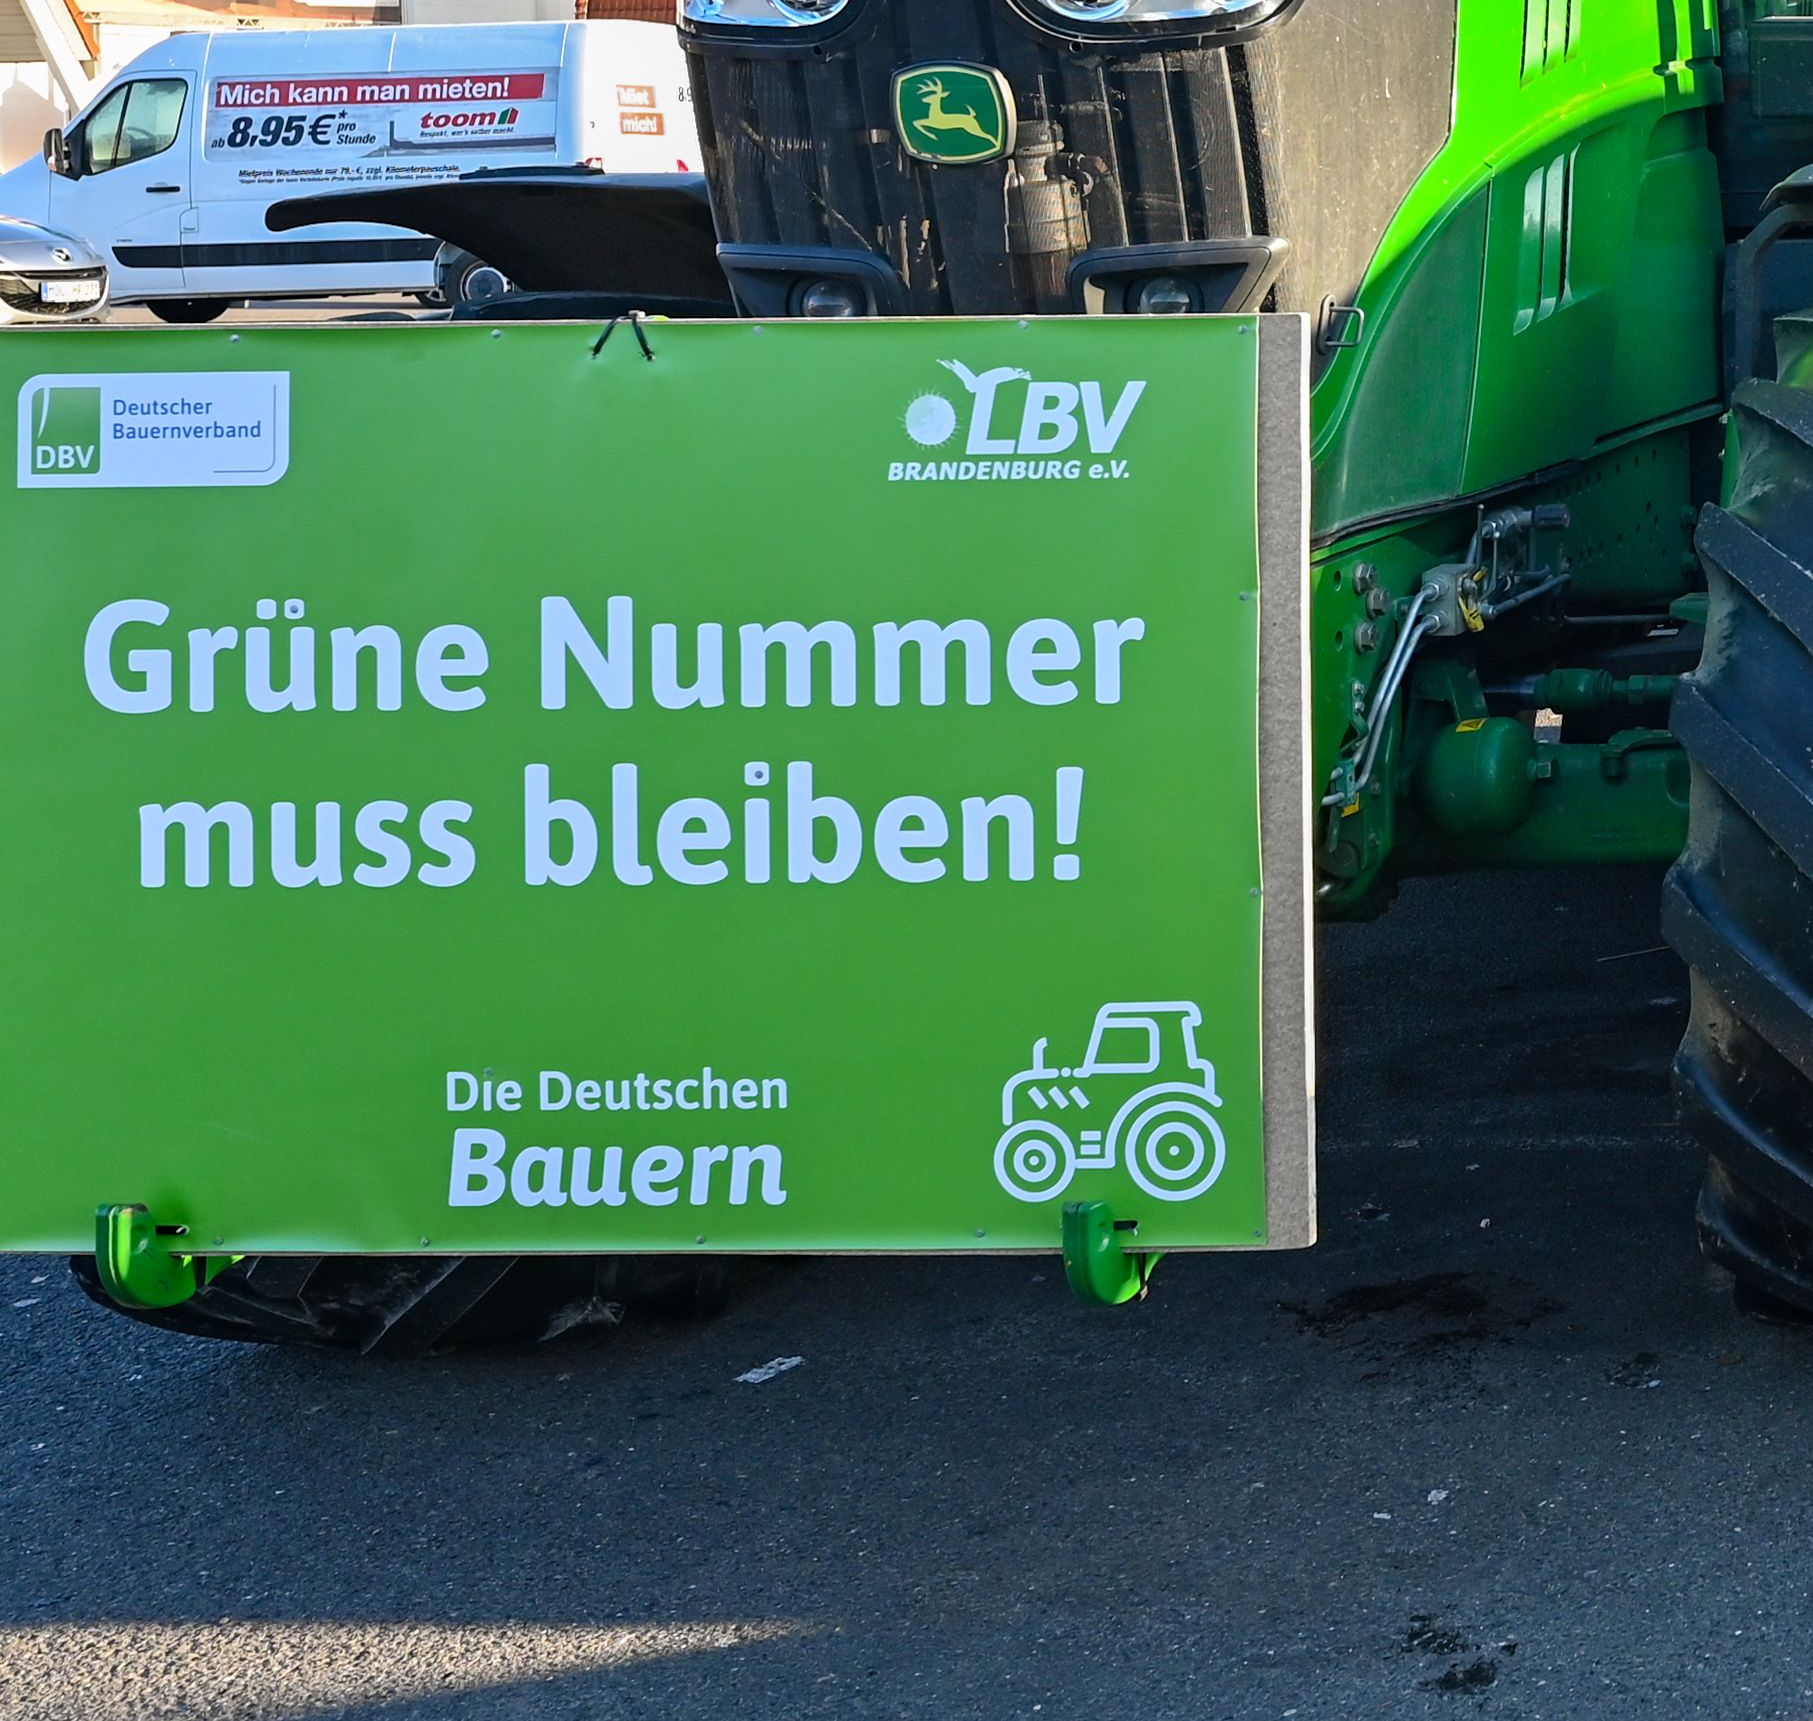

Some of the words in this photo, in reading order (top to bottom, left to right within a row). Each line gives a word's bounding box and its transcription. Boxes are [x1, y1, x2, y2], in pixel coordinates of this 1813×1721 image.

[219, 84, 280, 105] Mich
[288, 82, 348, 103] kann
[356, 84, 410, 101] man
[418, 77, 510, 100] mieten!
[336, 122, 357, 134] pro
[420, 111, 497, 130] toom
[211, 137, 225, 149] ab
[336, 133, 377, 146] Stunde
[113, 398, 212, 416] Deutscher
[964, 367, 1147, 455] LBV
[113, 421, 261, 440] Bauernverband
[36, 445, 95, 469] DBV
[888, 461, 1081, 481] BRANDENBURG
[1088, 460, 1130, 479] e.V.
[84, 597, 489, 714] Grüne
[540, 595, 1146, 710] Nummer
[139, 799, 476, 888] muss
[524, 760, 1084, 886] bleiben!
[446, 1070, 521, 1111] Die
[540, 1066, 788, 1111] Deutschen
[447, 1126, 788, 1207] Bauern
